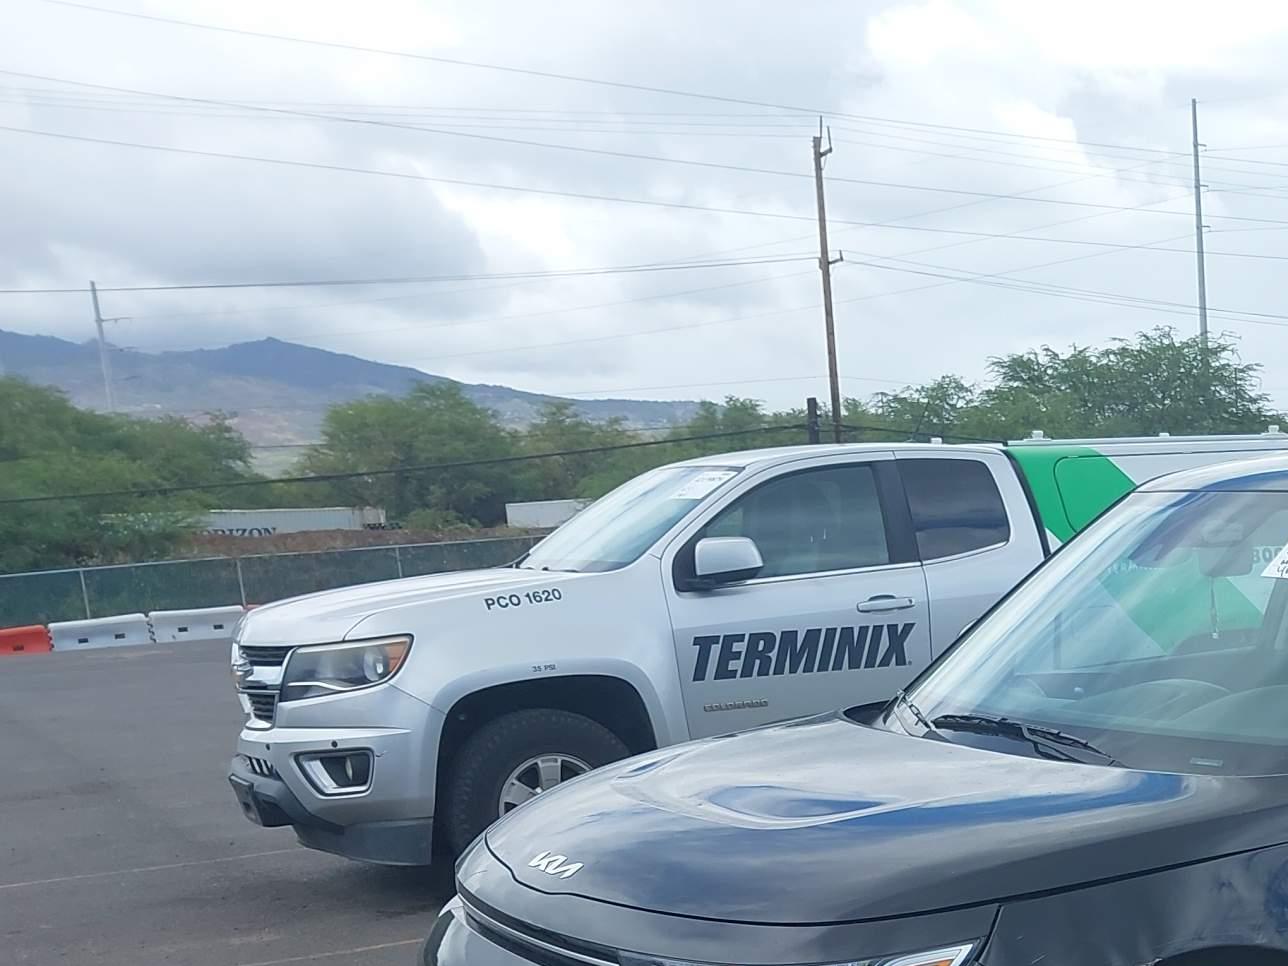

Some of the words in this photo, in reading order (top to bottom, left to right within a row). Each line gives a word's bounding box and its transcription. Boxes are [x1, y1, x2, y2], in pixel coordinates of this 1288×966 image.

[484, 594, 521, 611] PCO
[524, 588, 562, 604] 1620
[692, 622, 916, 682] TERMINIX
